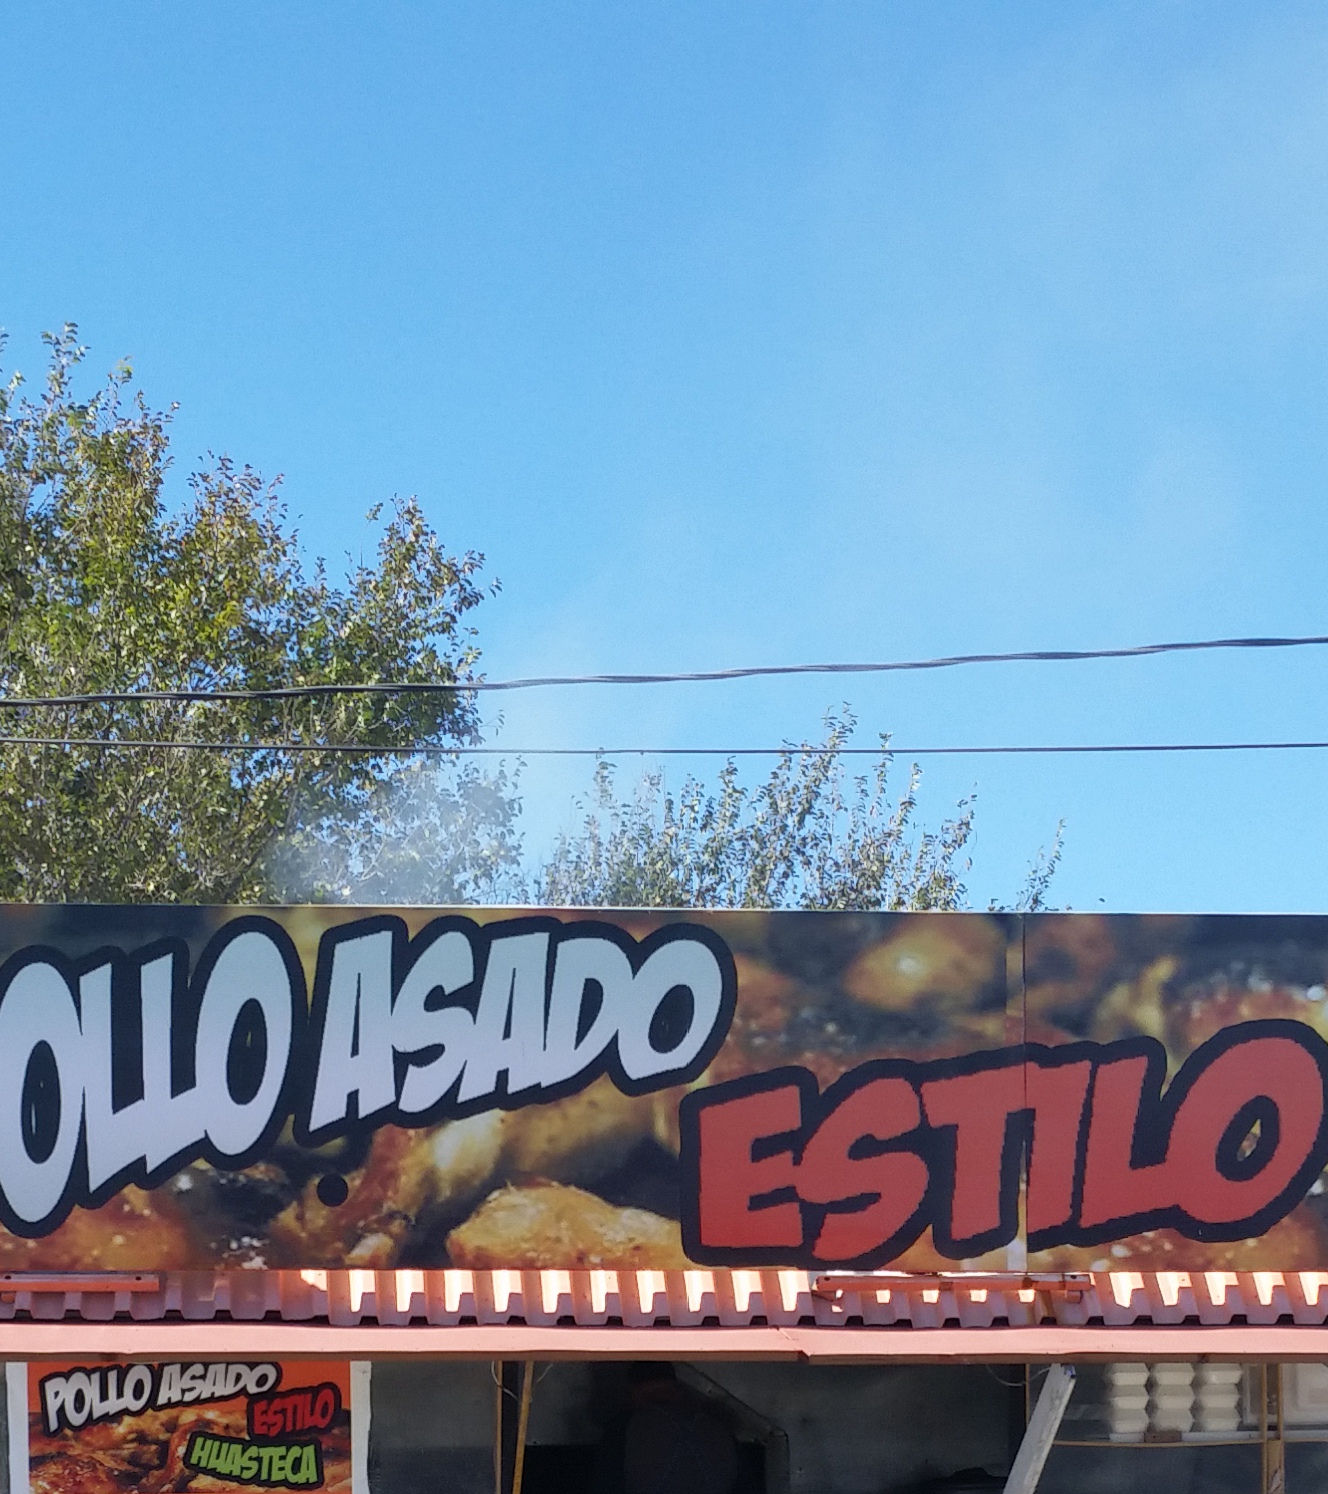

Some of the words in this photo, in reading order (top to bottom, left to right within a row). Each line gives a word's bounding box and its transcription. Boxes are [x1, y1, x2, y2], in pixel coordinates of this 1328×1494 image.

[305, 926, 726, 1136] ASADO
[695, 1035, 1328, 1264] ESTILO
[43, 1363, 152, 1433] POLLO
[156, 1362, 277, 1406] ASADO
[252, 1388, 337, 1436] ESTILO
[188, 1436, 319, 1485] HUASTECA
